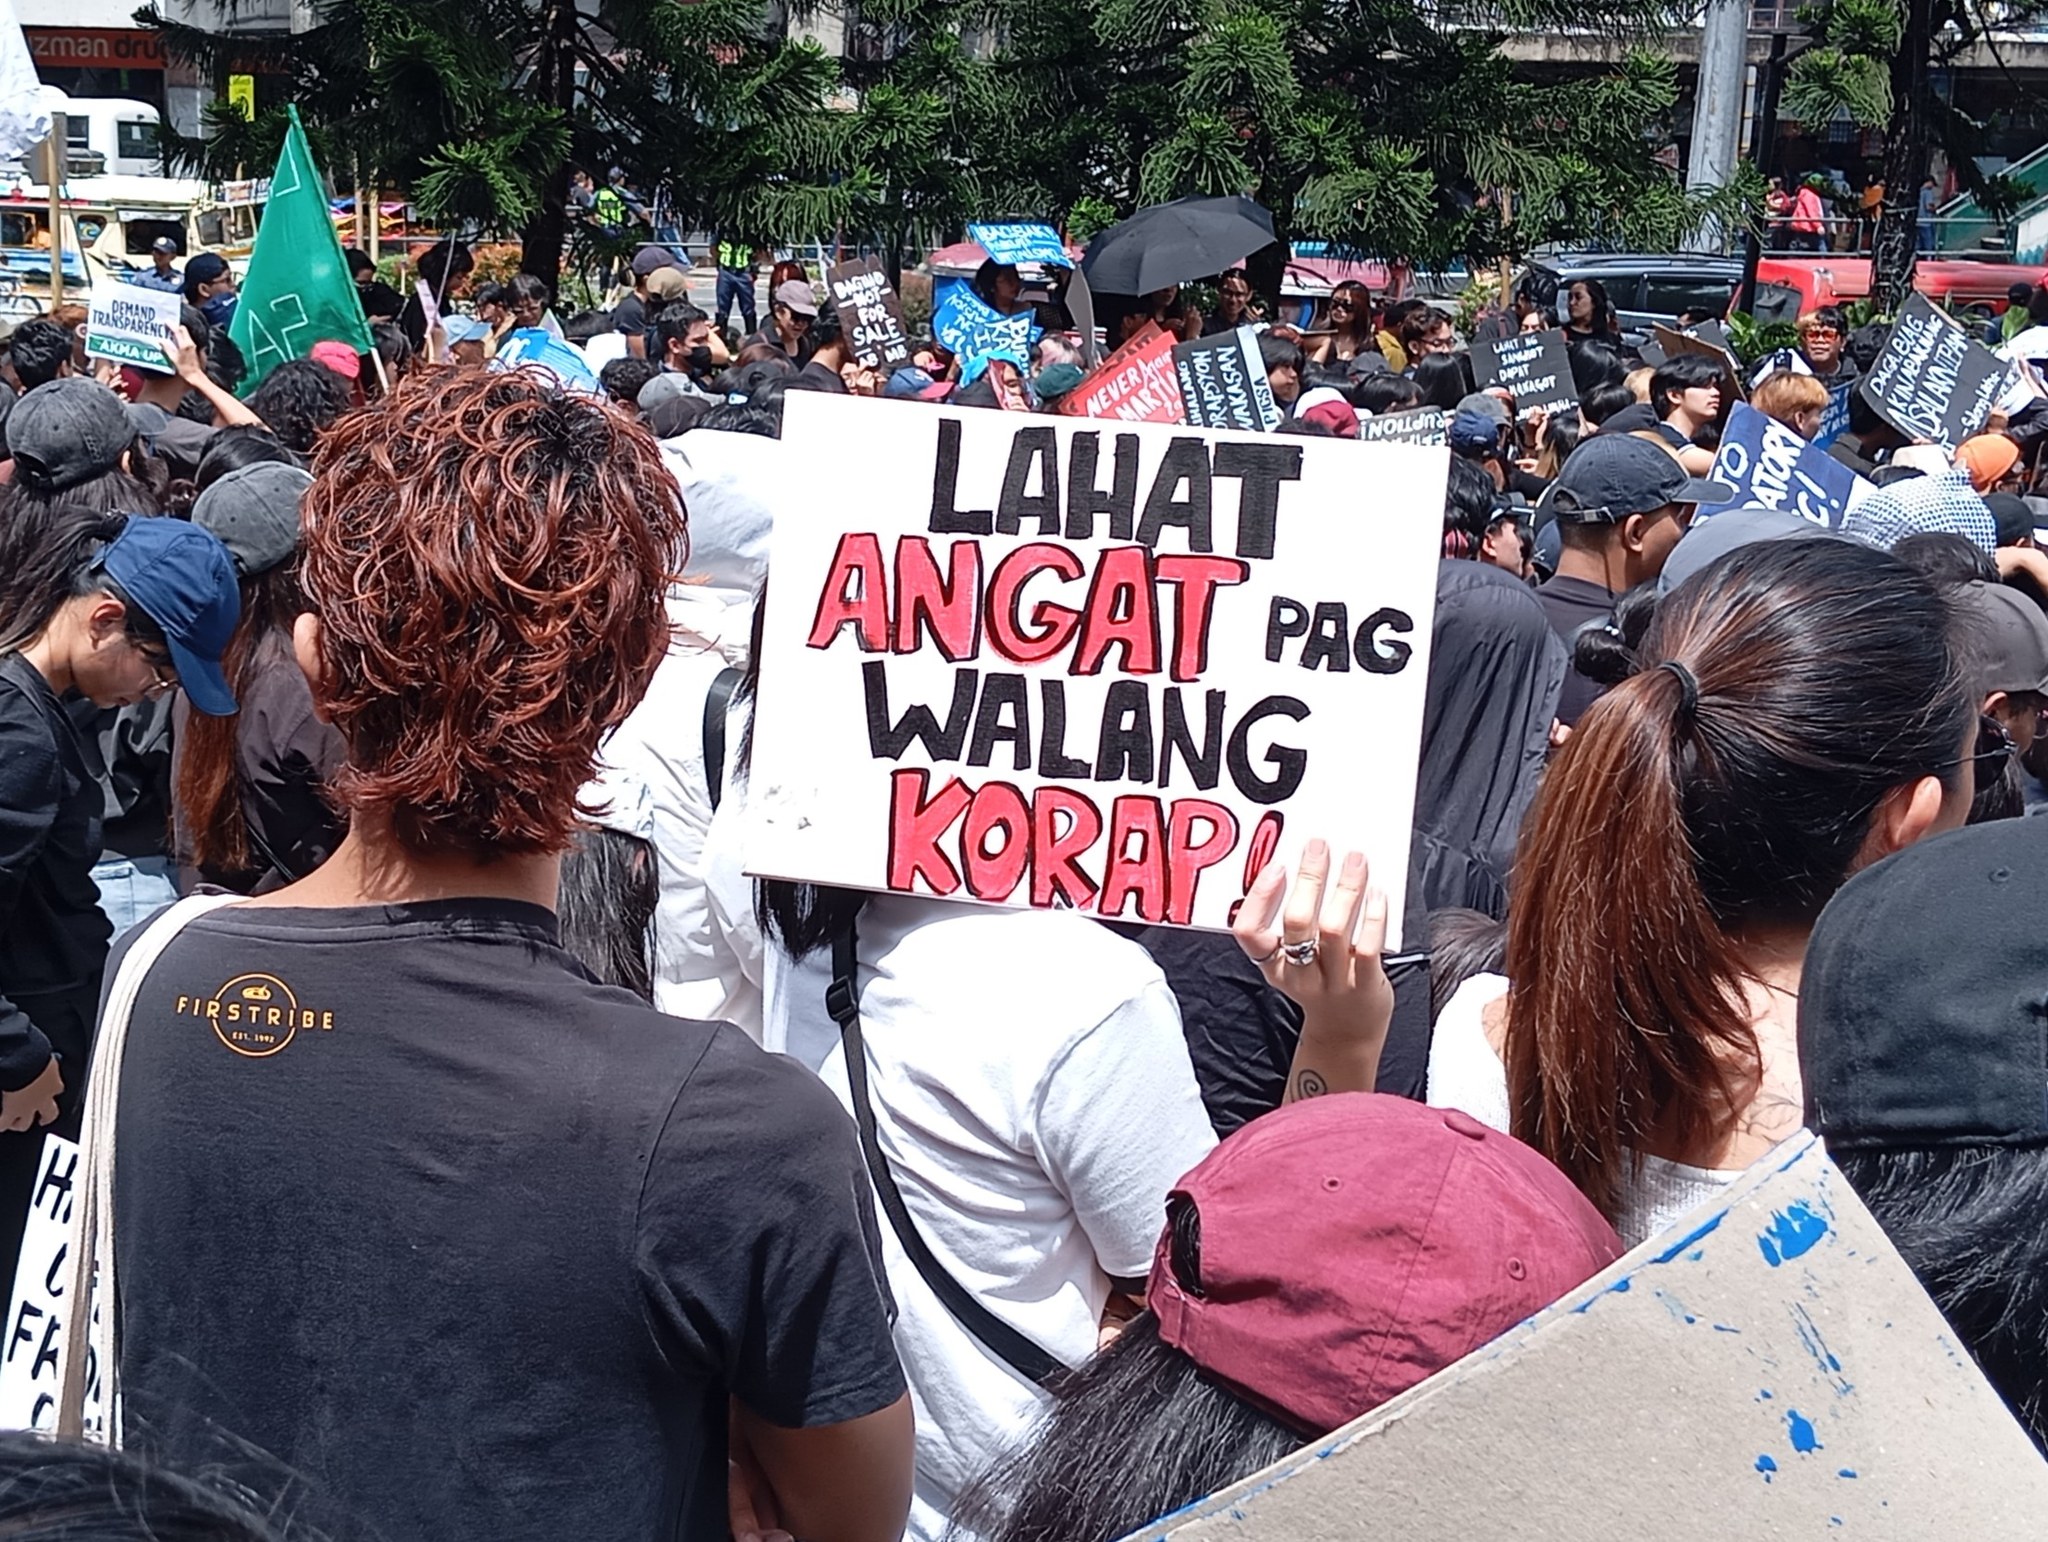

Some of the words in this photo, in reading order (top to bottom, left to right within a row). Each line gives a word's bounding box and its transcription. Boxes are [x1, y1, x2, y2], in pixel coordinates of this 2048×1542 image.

[28, 35, 109, 58] zman
[112, 299, 155, 320] DEMAND
[858, 304, 889, 326] FOR
[853, 317, 900, 346] SALE
[1525, 335, 1538, 347] NG
[1087, 366, 1143, 418] NEVER
[1191, 350, 1228, 429] ORAPSYON
[1499, 363, 1530, 382] DAPAT
[1742, 416, 1806, 511] ATORY
[928, 418, 1303, 559] LAHAT
[807, 532, 1250, 681] ANGAT
[1265, 595, 1414, 674] PAG
[862, 660, 1312, 804] WALANG
[886, 767, 1285, 925] KORAP!
[177, 996, 333, 1030] FIRSTRIBE
